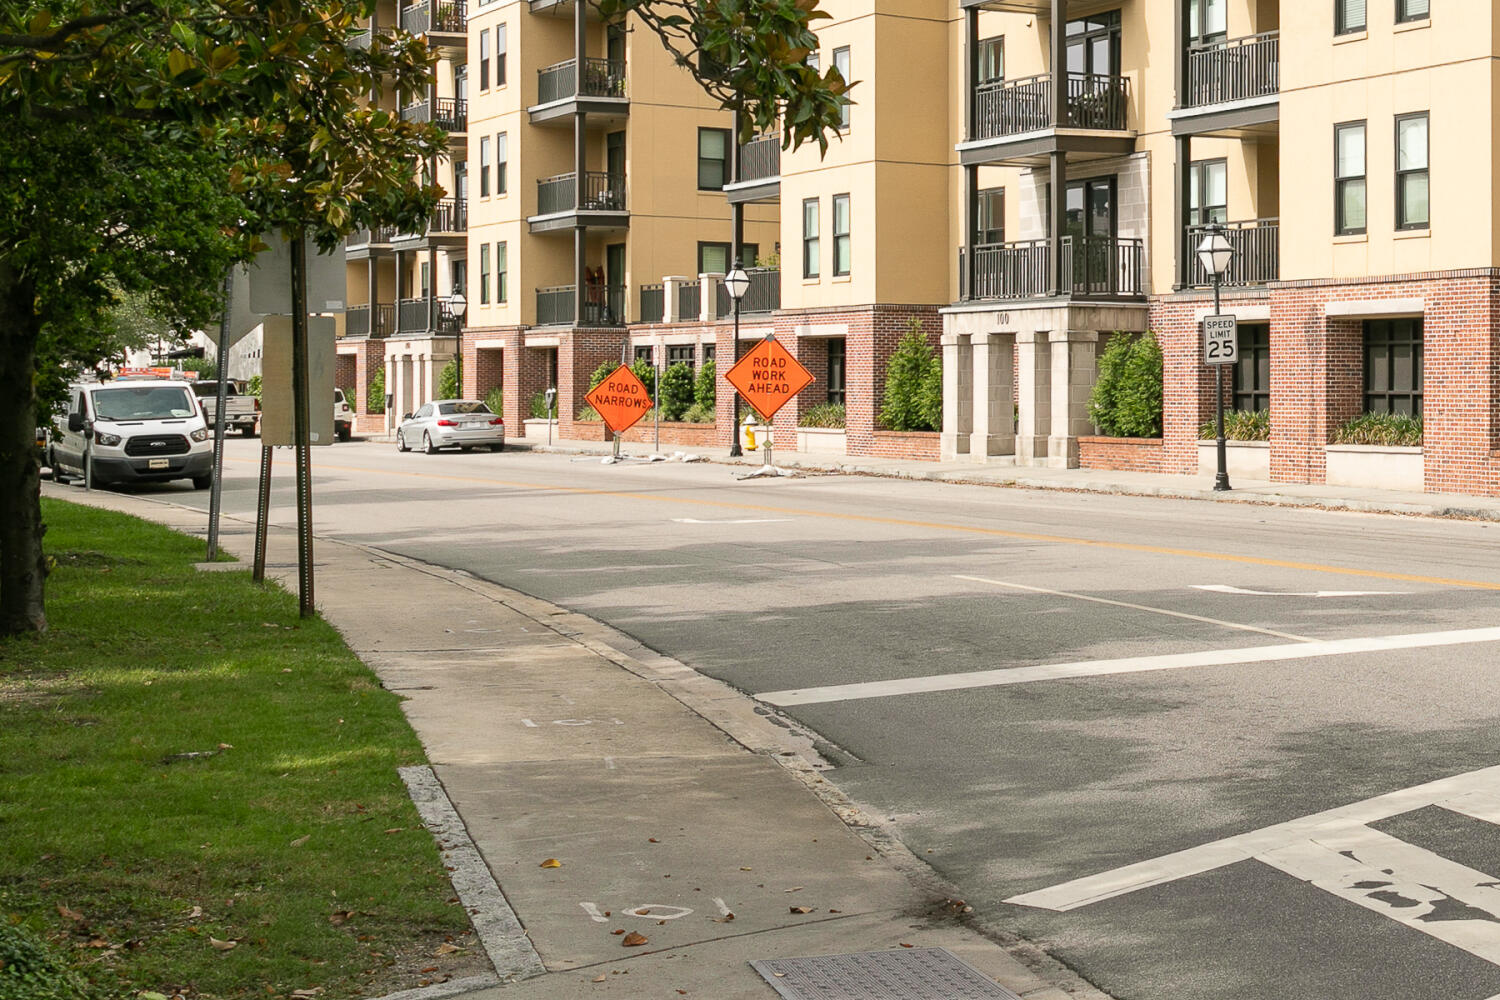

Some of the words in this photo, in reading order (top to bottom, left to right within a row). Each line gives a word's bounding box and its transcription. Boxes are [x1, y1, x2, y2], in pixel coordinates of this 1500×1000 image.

[997, 312, 1010, 325] 100
[1206, 320, 1234, 329] SPEED
[1210, 330, 1231, 339] LIMIT
[1208, 340, 1234, 358] 25
[753, 356, 787, 368] ROAD
[752, 370, 786, 380] WORK
[608, 382, 639, 394] ROAD
[748, 383, 790, 394] AHEAD
[594, 394, 648, 408] NARROWS
